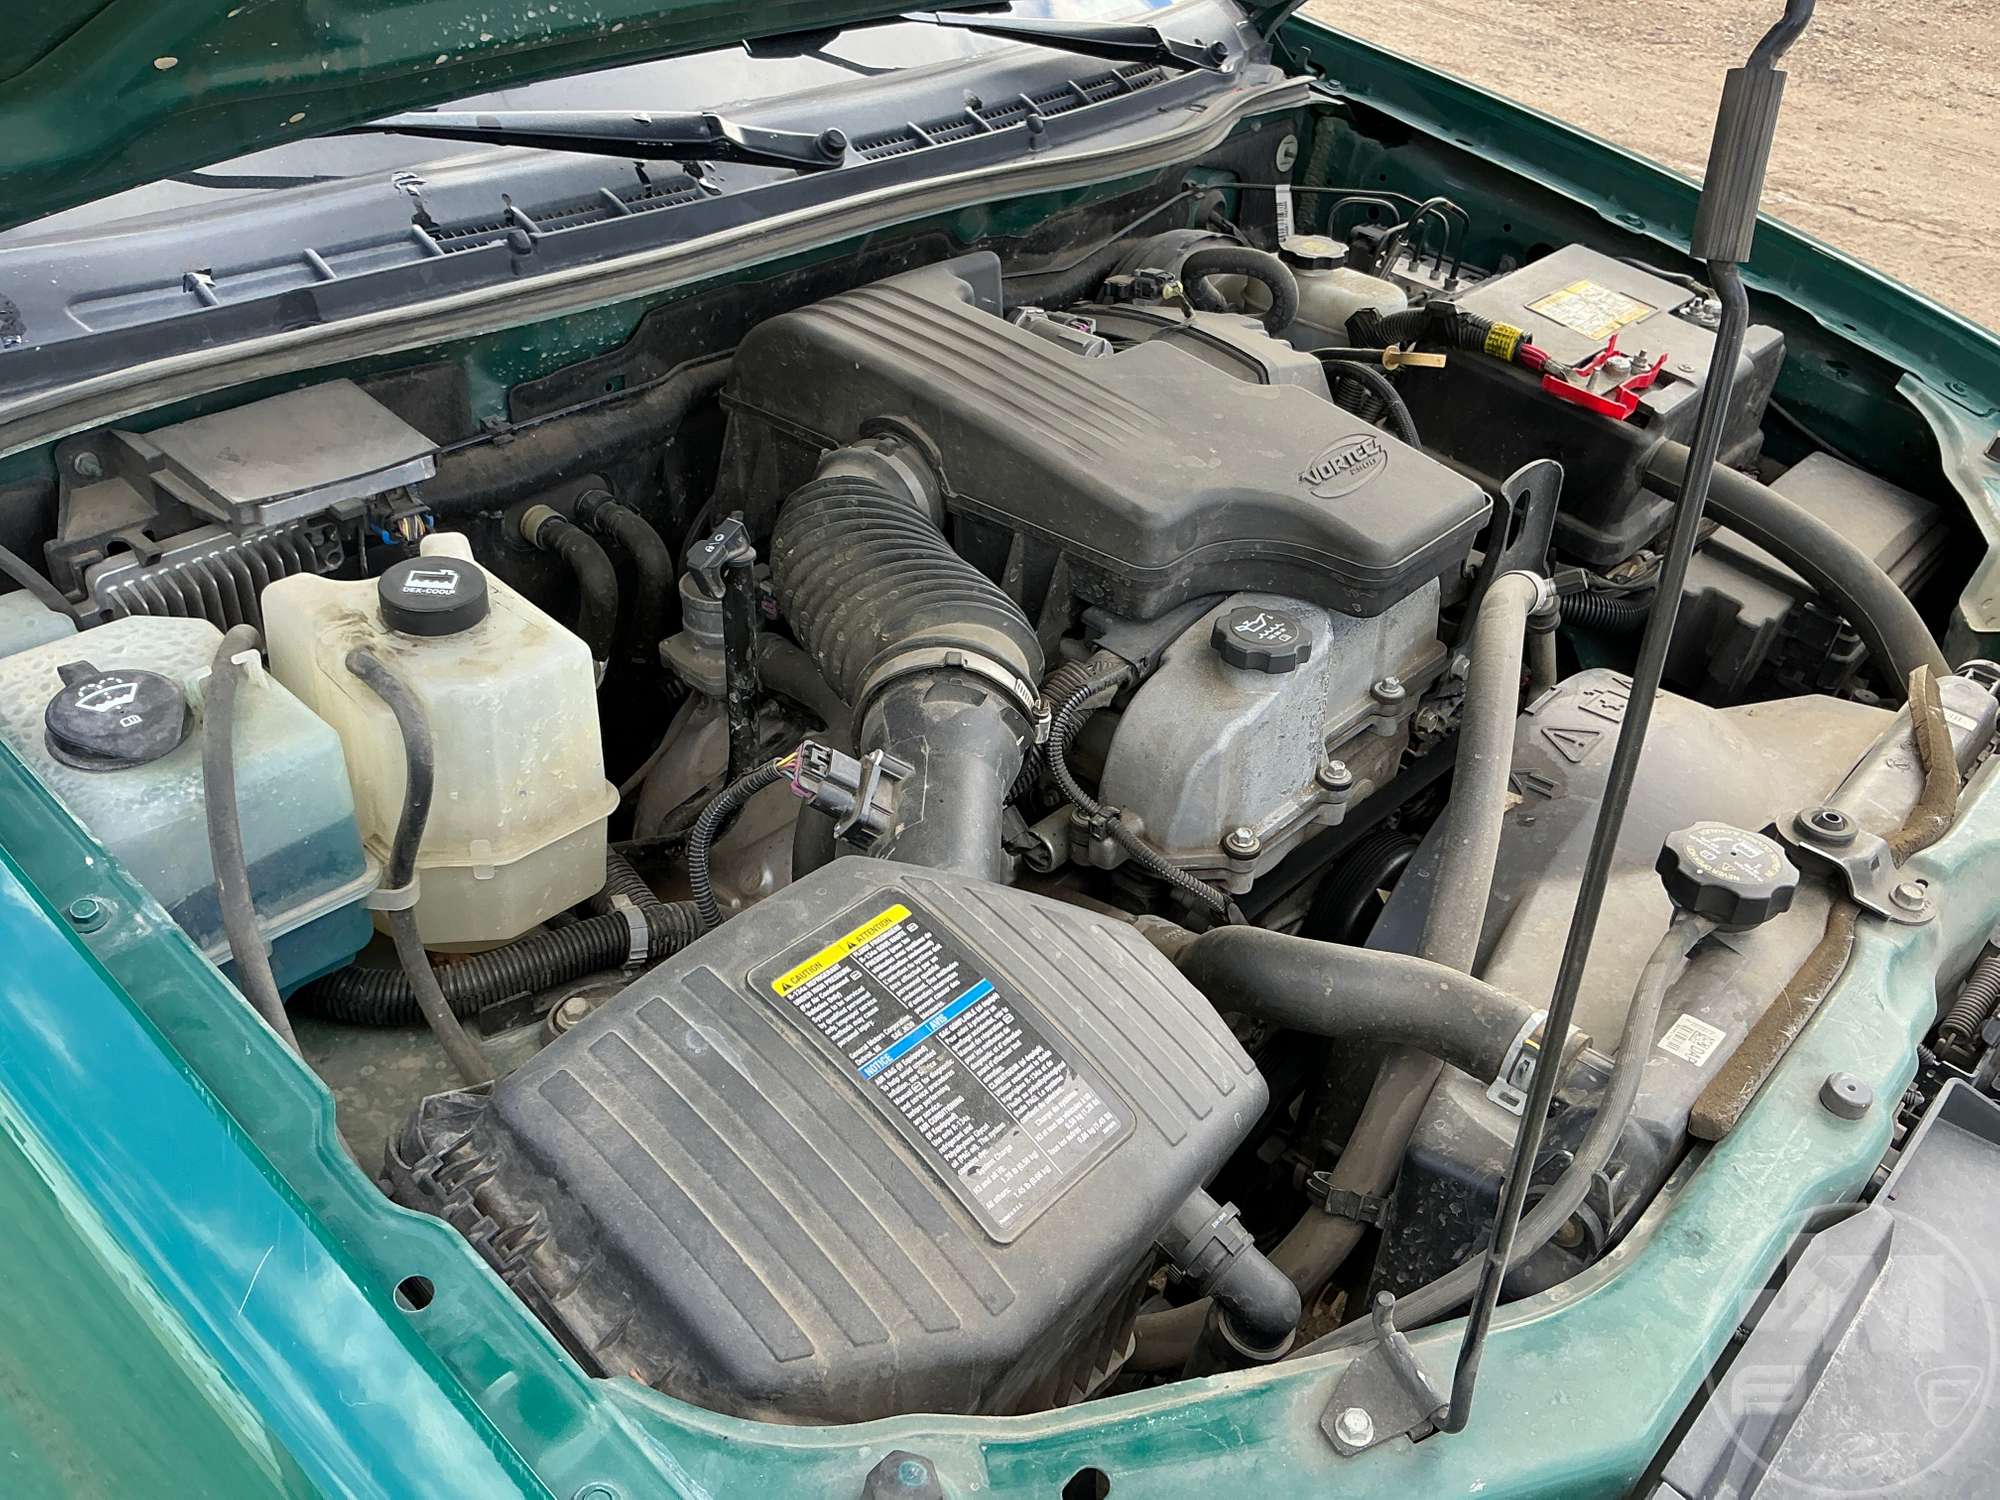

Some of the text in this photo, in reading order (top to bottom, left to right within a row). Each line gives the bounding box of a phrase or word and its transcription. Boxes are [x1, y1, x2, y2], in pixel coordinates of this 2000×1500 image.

[1301, 438, 1381, 486] VORTEC
[855, 916, 892, 942] ATTENTION
[789, 961, 822, 984] CAUTION
[927, 1012, 947, 1029] AVIS
[862, 1052, 892, 1076] NOTICE
